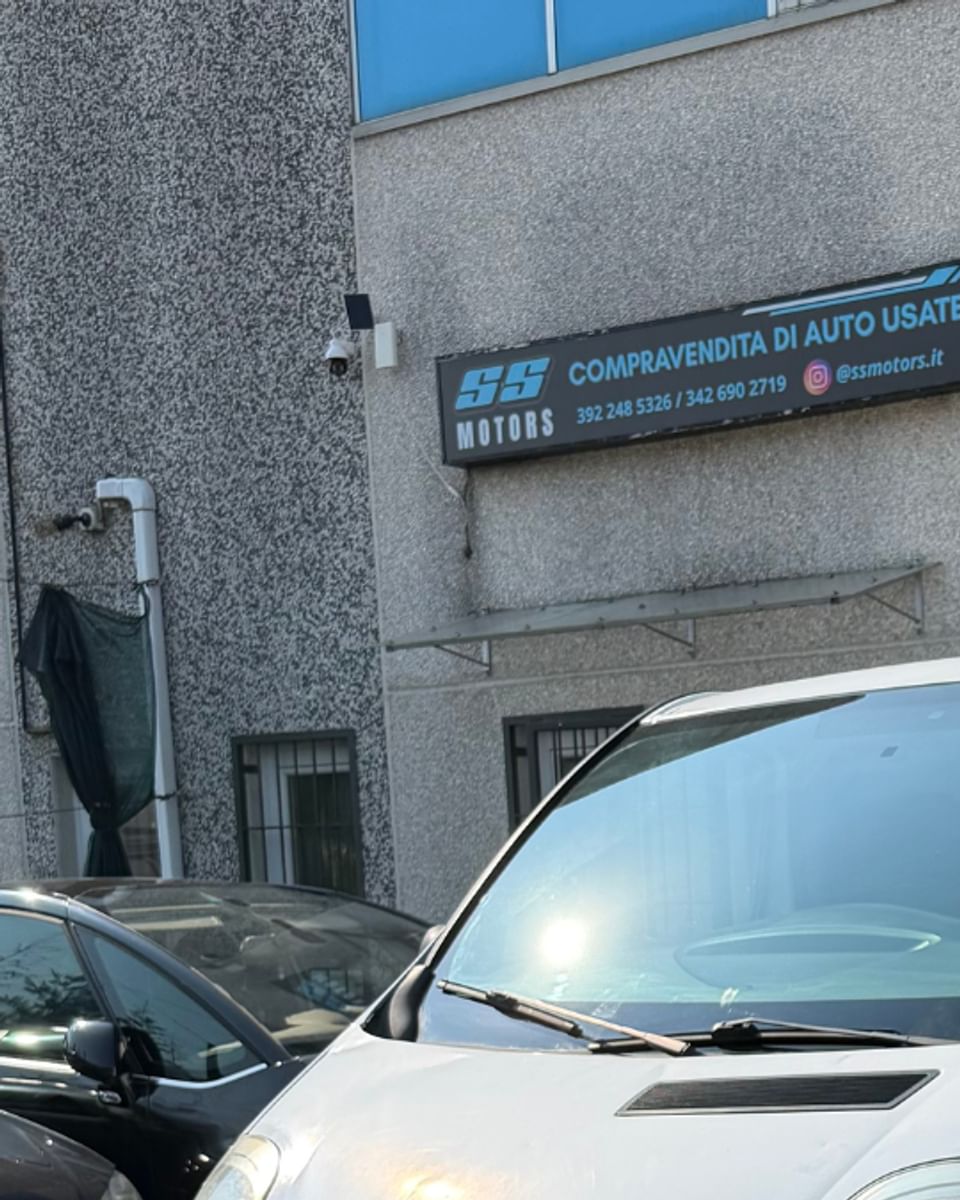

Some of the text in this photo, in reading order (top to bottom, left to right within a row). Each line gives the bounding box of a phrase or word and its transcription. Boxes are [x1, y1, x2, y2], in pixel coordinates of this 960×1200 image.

[568, 330, 768, 386] COMPRAVENDITA
[773, 324, 797, 352] DI
[803, 311, 876, 347] AUTO
[836, 347, 944, 384] @ssmotors.it
[455, 357, 551, 410] SS
[576, 375, 787, 425] 392 248 5326 / 342 690 2719
[456, 408, 554, 450] MOTORS
